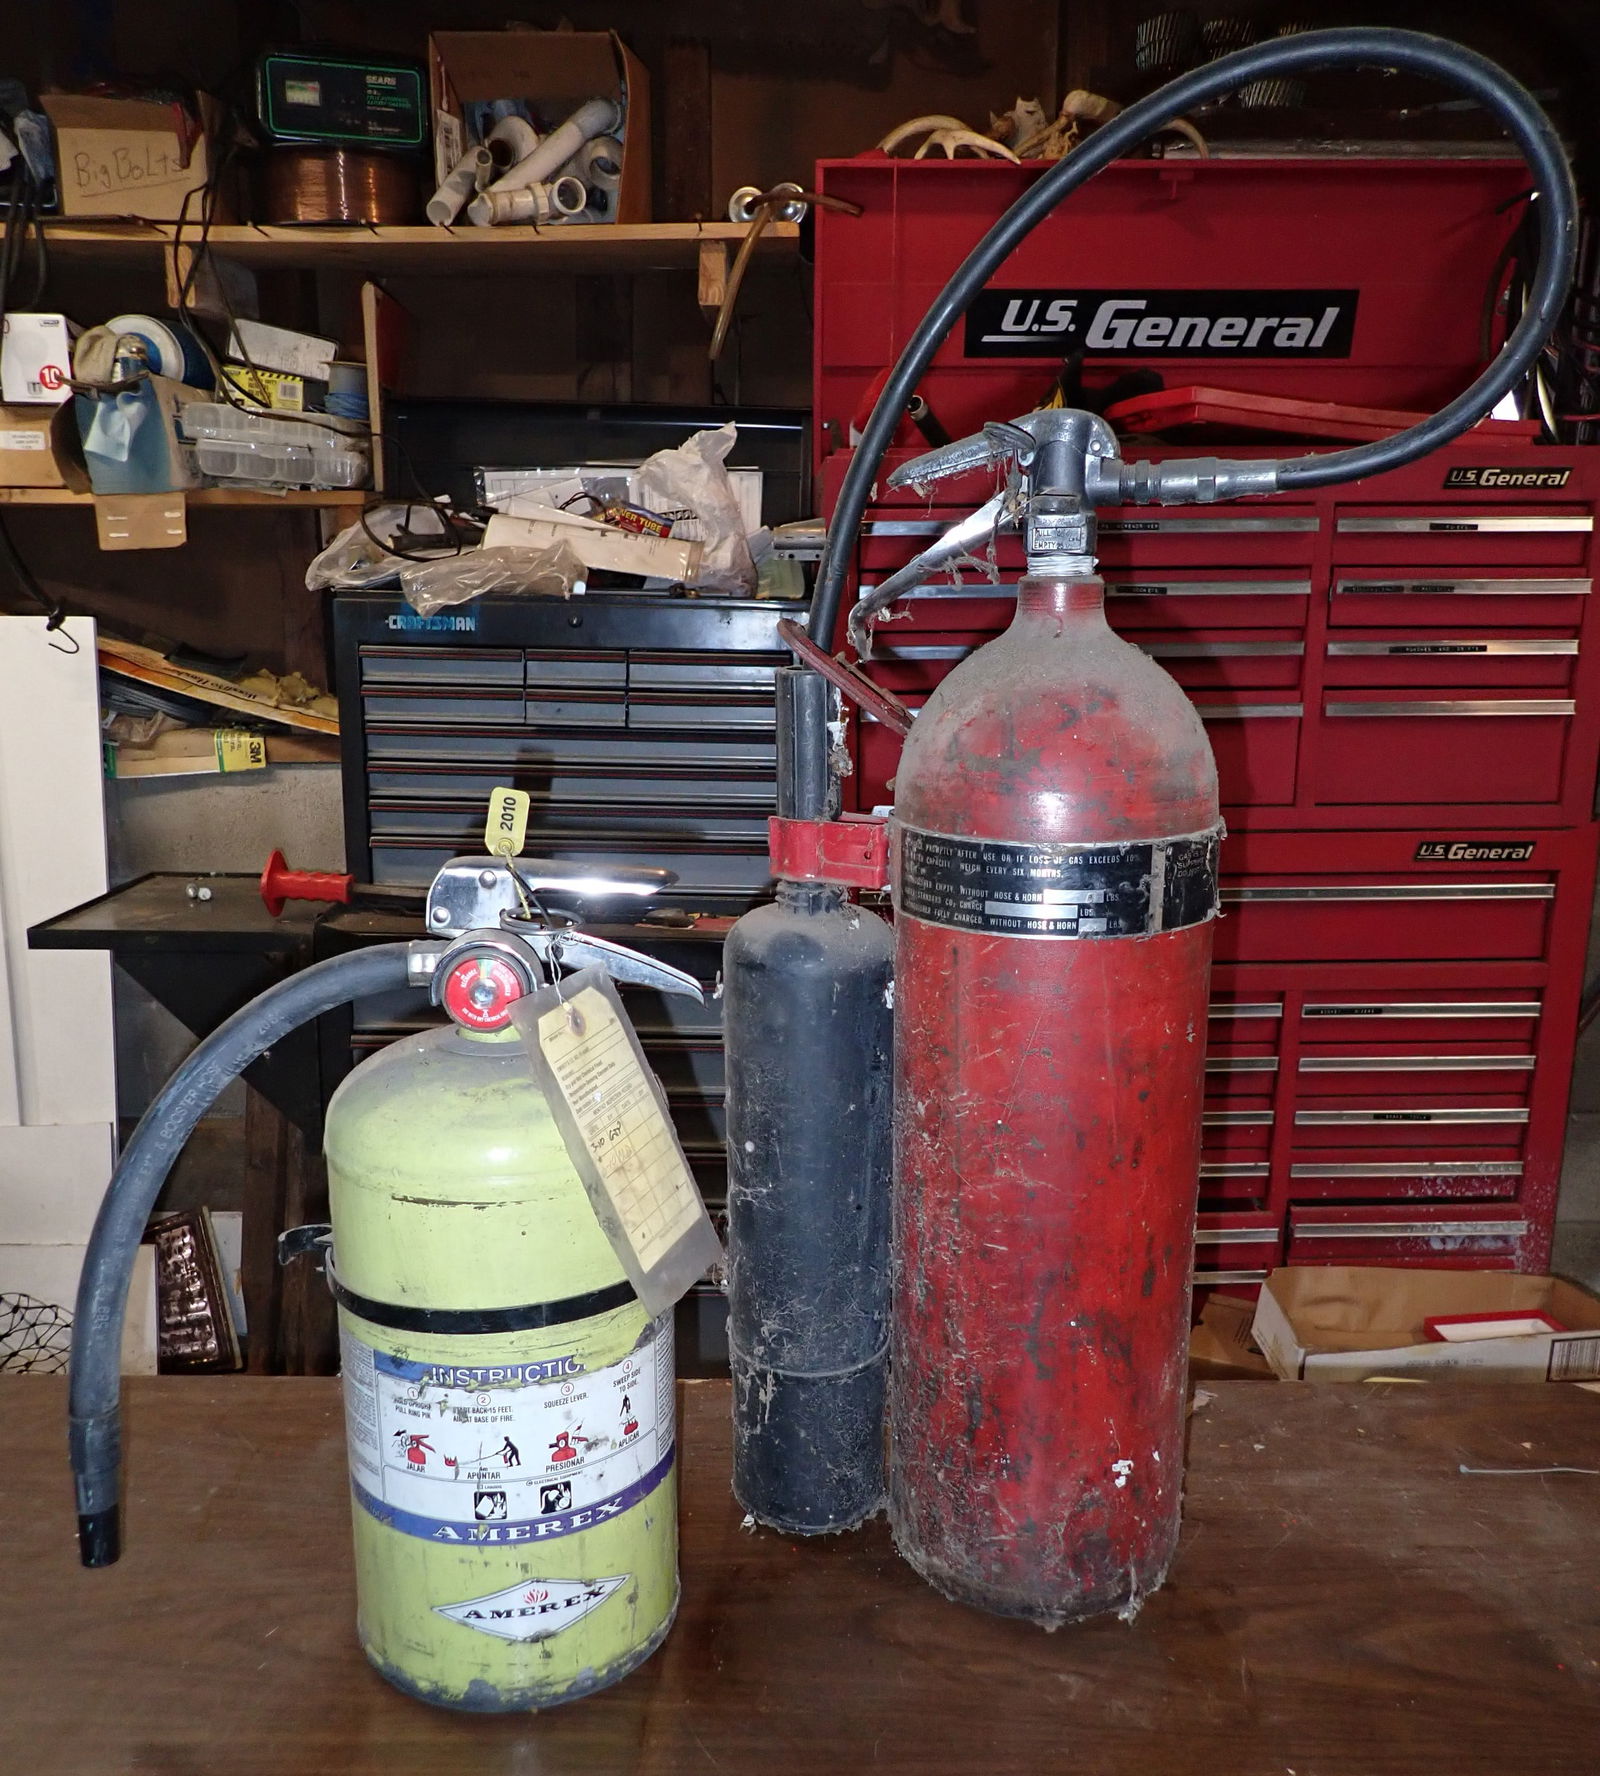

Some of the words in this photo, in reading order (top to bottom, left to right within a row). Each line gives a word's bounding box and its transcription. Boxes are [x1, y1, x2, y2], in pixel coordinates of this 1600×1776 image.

[366, 75, 396, 85] SEARS
[75, 152, 111, 189] Big
[1000, 299, 1077, 332] U.S.
[1085, 300, 1341, 349] General
[1450, 470, 1477, 481] U.S.
[1480, 469, 1570, 486] General
[639, 516, 663, 536] TUBE
[1034, 541, 1056, 549] EMPTY
[388, 615, 475, 631] CRAFTSMAN
[249, 741, 262, 764] 3M
[500, 797, 517, 831] 2010
[1447, 844, 1534, 859] General
[1016, 855, 1024, 863] IF
[1068, 856, 1083, 865] GAS
[1089, 855, 1120, 864] EXCEEDS
[986, 865, 1007, 875] EVERY
[1012, 867, 1024, 876] SIX
[960, 885, 989, 898] WITHOUT
[994, 891, 1012, 900] HOSE
[1022, 893, 1043, 902] HORN
[990, 918, 1021, 928] WITHOUT
[1027, 921, 1047, 930] HOSE
[1048, 921, 1055, 930] &
[1056, 921, 1077, 930] HORN
[430, 1358, 586, 1387] INSTRUCTIO
[612, 1373, 631, 1388] SWEEP
[631, 1368, 641, 1378] SIDE
[619, 1384, 626, 1393] TO
[395, 1405, 408, 1414] PULL
[544, 1396, 569, 1409] SQUEEZE
[618, 1431, 640, 1448] APLICAR
[406, 1462, 426, 1473] JALAR
[545, 1457, 585, 1473] PRESIONAR
[467, 1472, 501, 1480] APUNTAR
[433, 1497, 623, 1541] AMEREX
[463, 1585, 605, 1619] AMEREX
